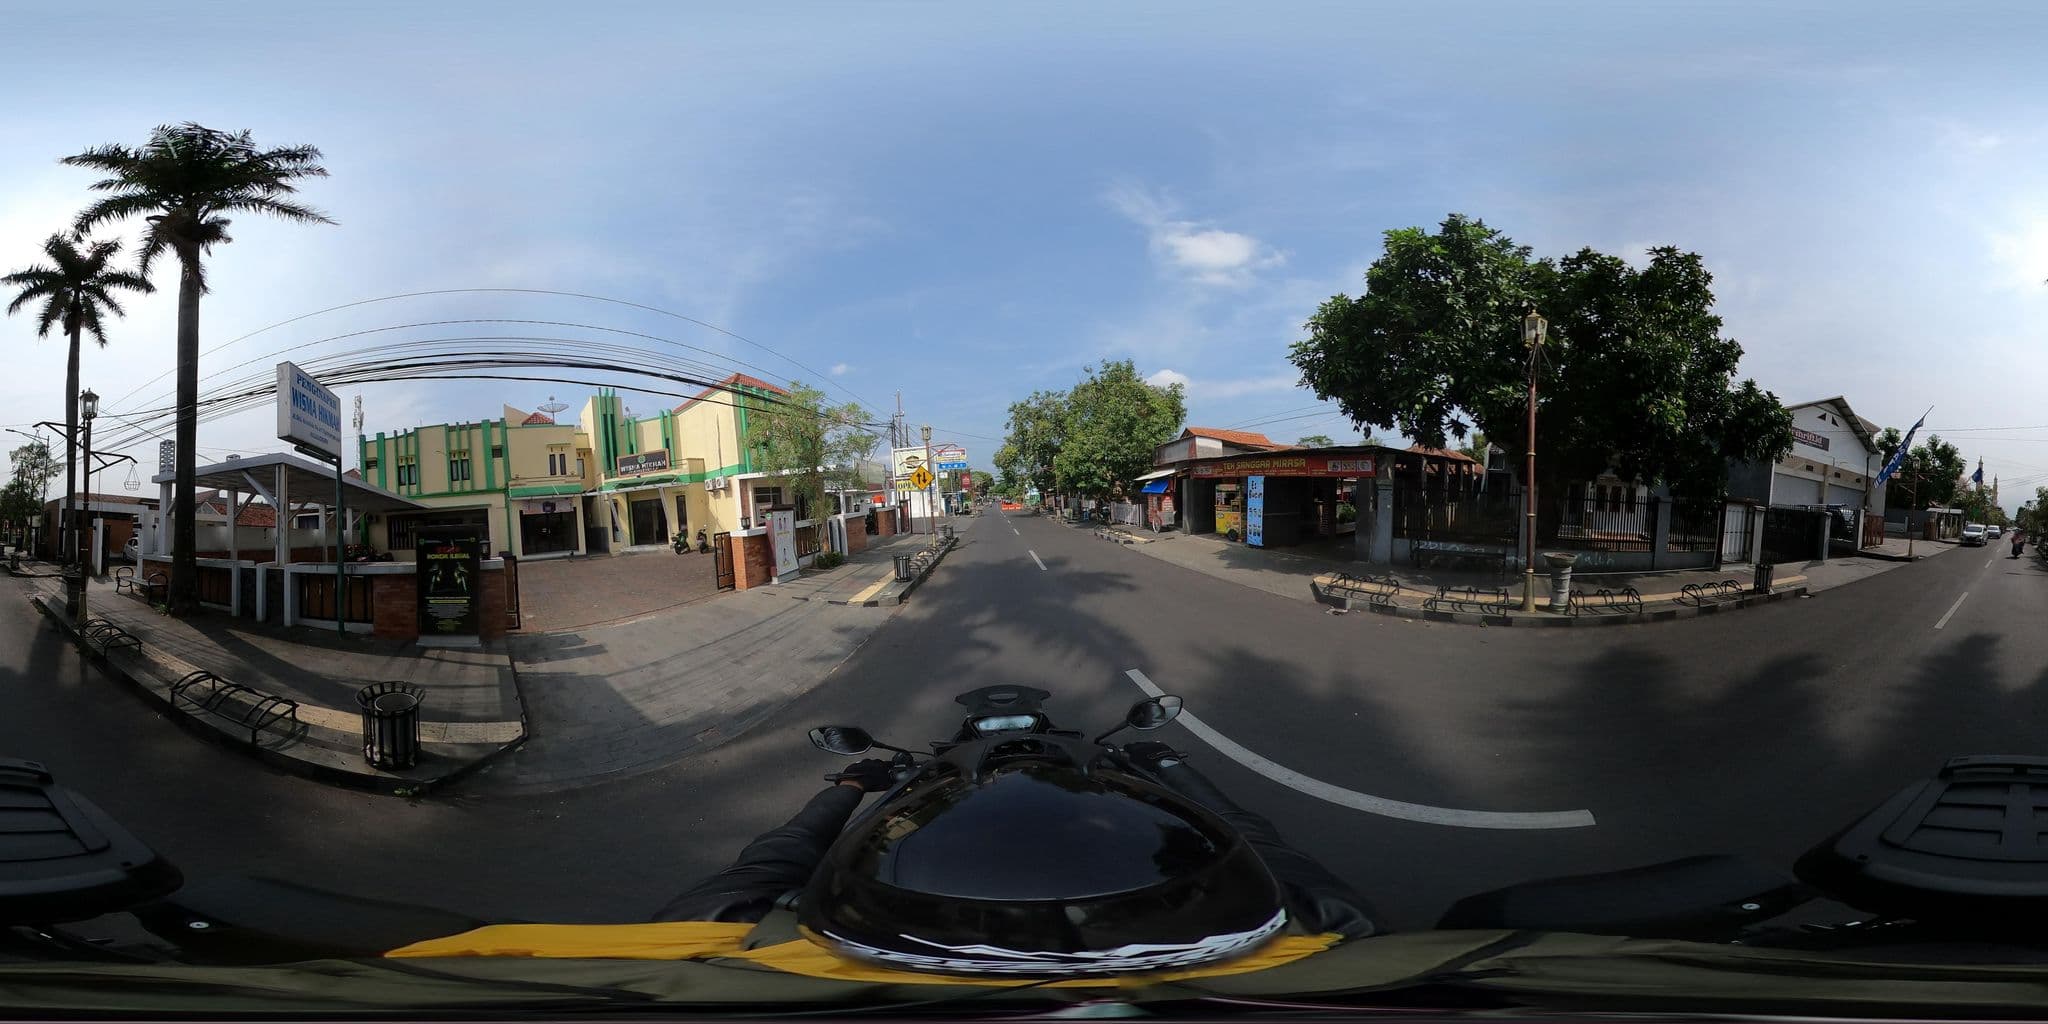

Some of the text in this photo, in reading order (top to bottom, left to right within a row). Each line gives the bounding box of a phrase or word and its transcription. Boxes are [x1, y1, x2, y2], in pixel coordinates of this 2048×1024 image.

[292, 386, 317, 419] WISMA
[319, 404, 341, 432] HIKMAH
[620, 463, 641, 472] WISMA
[1236, 460, 1271, 469] SANGGAR
[1272, 458, 1306, 467] MIRASA
